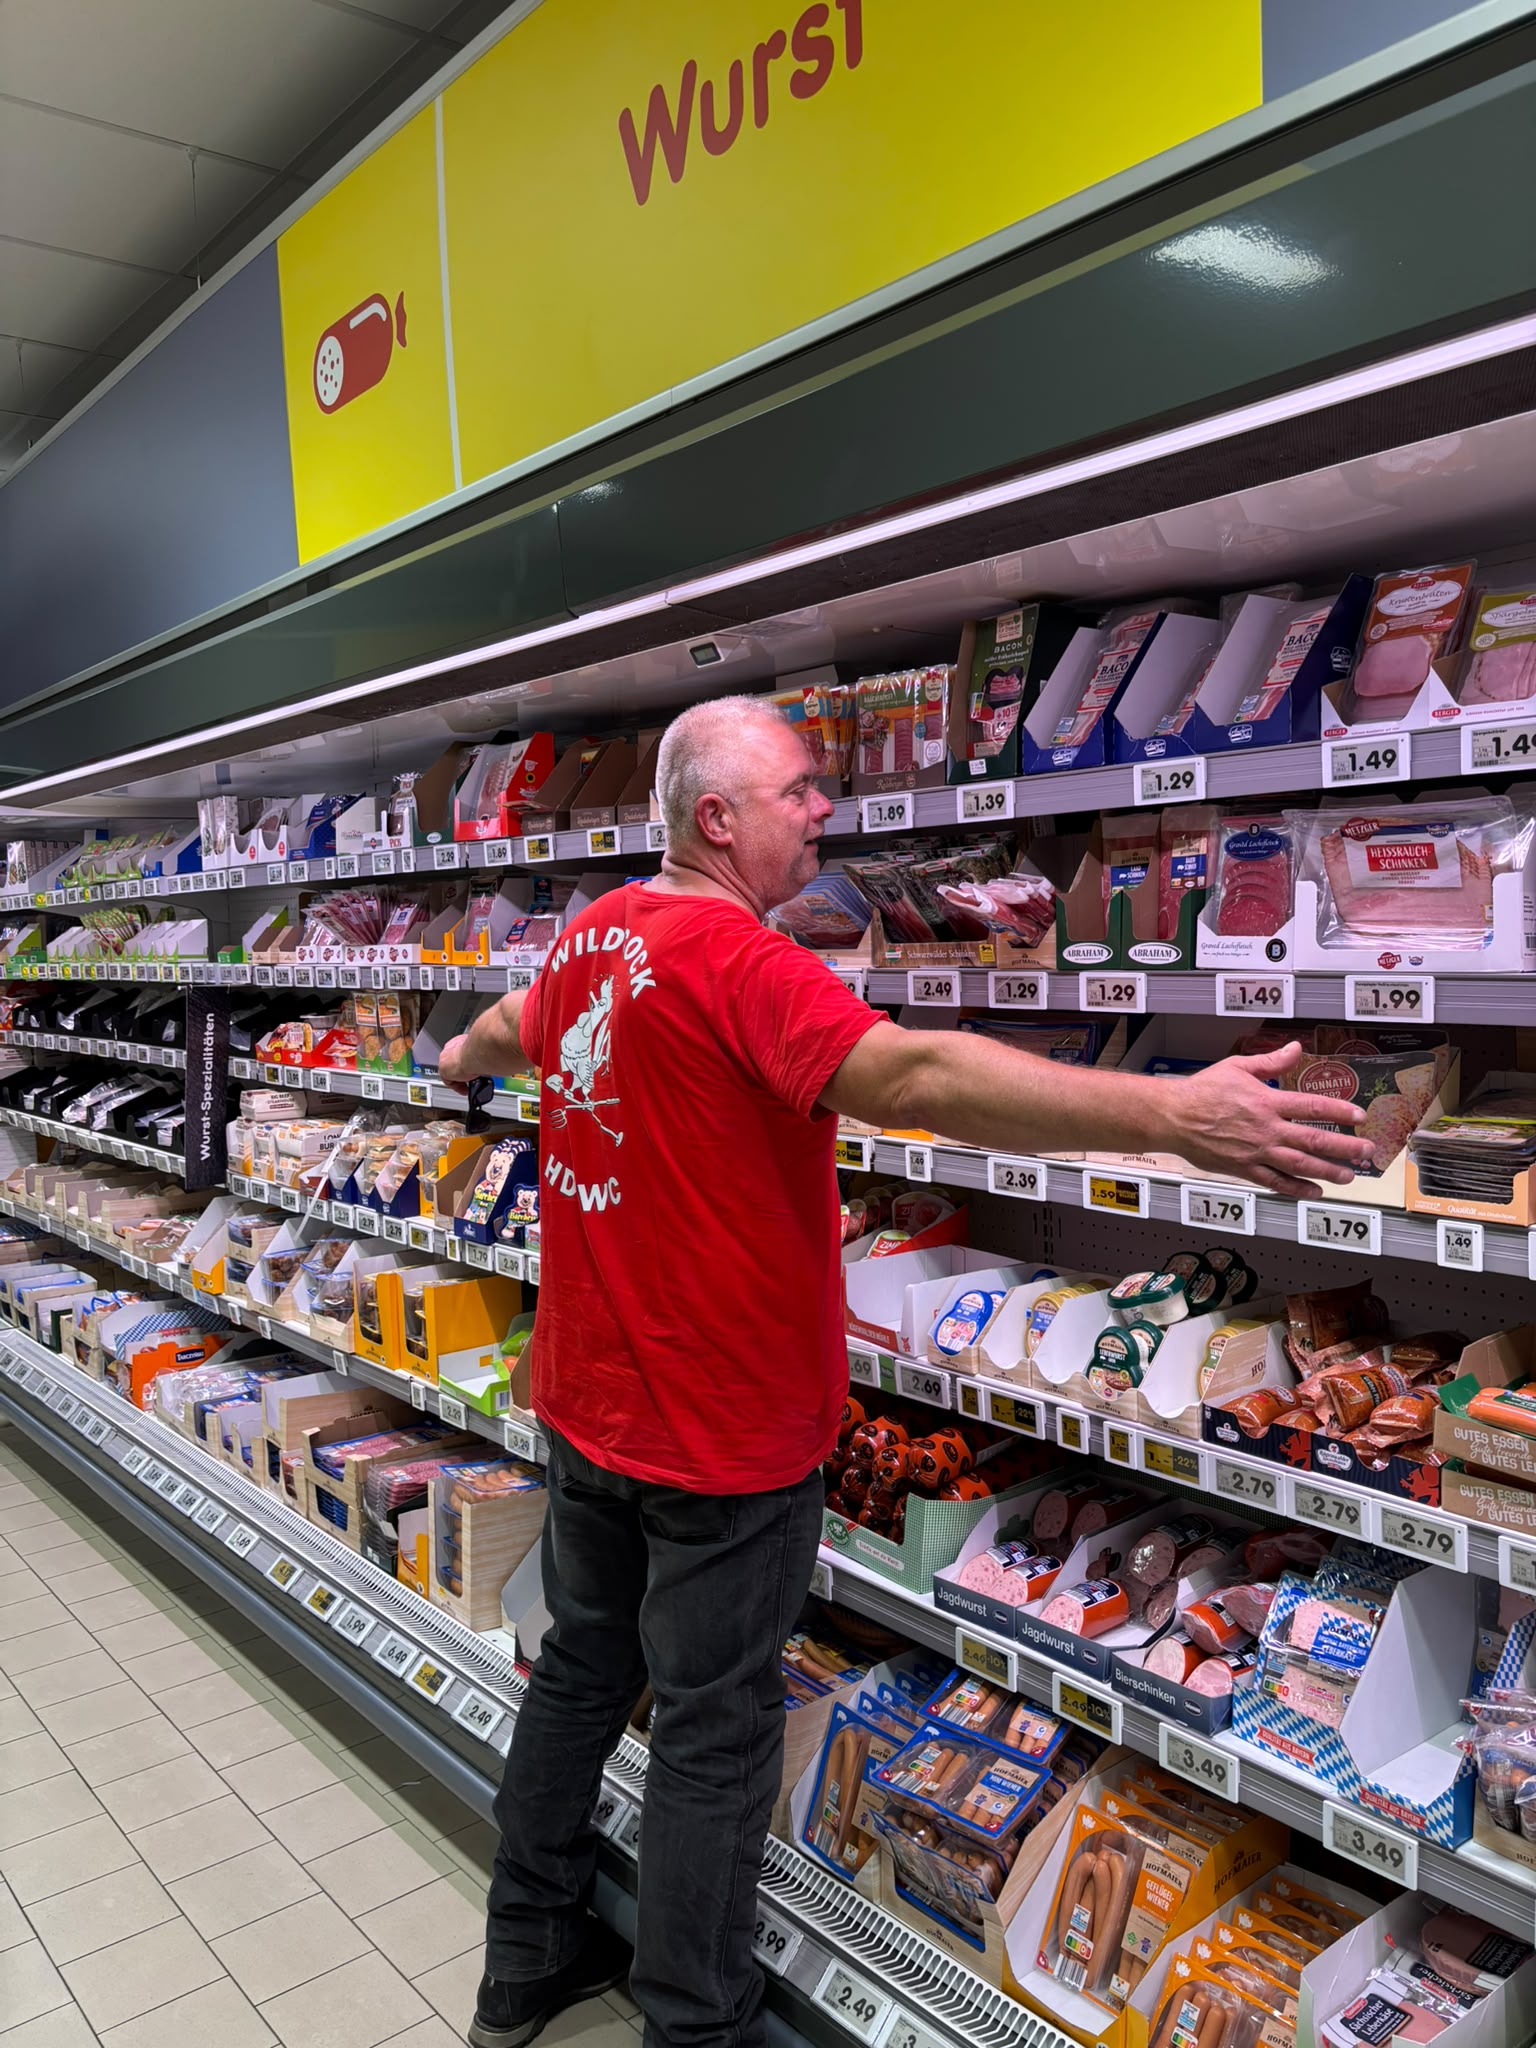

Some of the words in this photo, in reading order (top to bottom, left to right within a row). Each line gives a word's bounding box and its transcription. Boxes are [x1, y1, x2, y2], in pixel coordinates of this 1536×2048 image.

[994, 641, 1023, 653] BACON
[1286, 632, 1320, 647] BACO
[1100, 661, 1129, 675] BACO
[1434, 709, 1460, 718] BERGER
[1324, 728, 1348, 737] BERGER
[1349, 749, 1397, 772] 1.49
[1155, 771, 1194, 790] 1.29
[974, 793, 1005, 811] 1.39
[878, 805, 905, 822] 1.89
[1344, 822, 1379, 836] METZGER
[389, 838, 402, 848] PICK
[1370, 845, 1432, 857] HEISSRAUCH-
[1380, 858, 1428, 869] SCHINKEN
[907, 949, 948, 960] Schwarzwälder
[949, 950, 977, 959] Schinken
[1067, 949, 1104, 959] ABRAHAM
[1132, 948, 1173, 959] ABRAHAM
[515, 974, 531, 987] 2.49
[923, 981, 952, 996] 2.49
[1005, 982, 1038, 998] 1.29
[1099, 984, 1135, 1001] 1.29
[1239, 986, 1282, 1005] 1.49
[1371, 989, 1421, 1009] 1.99
[200, 1013, 215, 1161] Wurst-Spezialitäten
[1305, 1078, 1352, 1091] PONNATH
[1122, 1156, 1157, 1166] HOFMAIER
[544, 1153, 622, 1212] HDWC
[1006, 1171, 1037, 1189] 2.39
[1091, 1188, 1116, 1200] 1.59
[1203, 1200, 1243, 1221] 1.79
[1447, 1204, 1477, 1216] Qualität
[362, 1217, 375, 1228] 2.79
[388, 1224, 403, 1236] 2.79
[1322, 1217, 1369, 1239] 1.79
[1446, 1235, 1471, 1248] 1.49
[473, 1249, 488, 1263] 1.79
[504, 1258, 519, 1270] 2.39
[851, 1359, 872, 1375] .69
[912, 1375, 941, 1397] 2.69
[447, 1407, 462, 1420] 2.29
[514, 1438, 530, 1452] 3.29
[1454, 1427, 1489, 1443] GUTES
[1492, 1434, 1529, 1453] ESSEN
[1174, 1455, 1198, 1470] -22%
[1481, 1452, 1517, 1470] GUTES
[164, 1479, 178, 1493] 1.69
[1232, 1471, 1275, 1499] 2.79
[182, 1492, 196, 1507] 1.69
[1460, 1484, 1494, 1500] GUTES
[1497, 1490, 1534, 1507] ESSEN
[1312, 1496, 1360, 1524] 2.79
[1487, 1509, 1523, 1525] GUTES
[235, 1533, 251, 1548] 1.69
[1401, 1522, 1453, 1554] 2.79
[937, 1586, 988, 1617] Jagdwurst
[346, 1615, 366, 1634] 1.99
[1021, 1622, 1076, 1657] Jagdwurst
[387, 1645, 408, 1664] 6.49
[1114, 1667, 1176, 1706] Bierschinken
[469, 1704, 492, 1726] 2.49
[1088, 1703, 1112, 1721] -10%
[871, 1747, 891, 1759] HOFM
[1262, 1730, 1282, 1746] QUALITÄT
[1282, 1740, 1291, 1751] AUS
[1292, 1745, 1311, 1761] BAYERN
[1183, 1750, 1226, 1783] 3.49
[994, 1766, 1029, 1786] HOFMAIER
[1001, 1778, 1022, 1792] WIENER
[1365, 1793, 1389, 1810] QUALITÄT
[1389, 1804, 1400, 1816] AUS
[1401, 1809, 1421, 1825] BAYERN
[1352, 1830, 1403, 1868] 3.49
[1145, 1862, 1184, 1889] HOFMAIER
[1214, 1851, 1262, 1895] HOFMAIER
[1146, 1879, 1175, 1903] GEFLÜGEL-
[1146, 1890, 1170, 1912] WIENER
[754, 1921, 786, 1954] 2.99
[838, 1987, 876, 2023] 2.49
[1349, 1999, 1384, 2034] Sächsischer
[1362, 2007, 1396, 2036] Leberkäse
